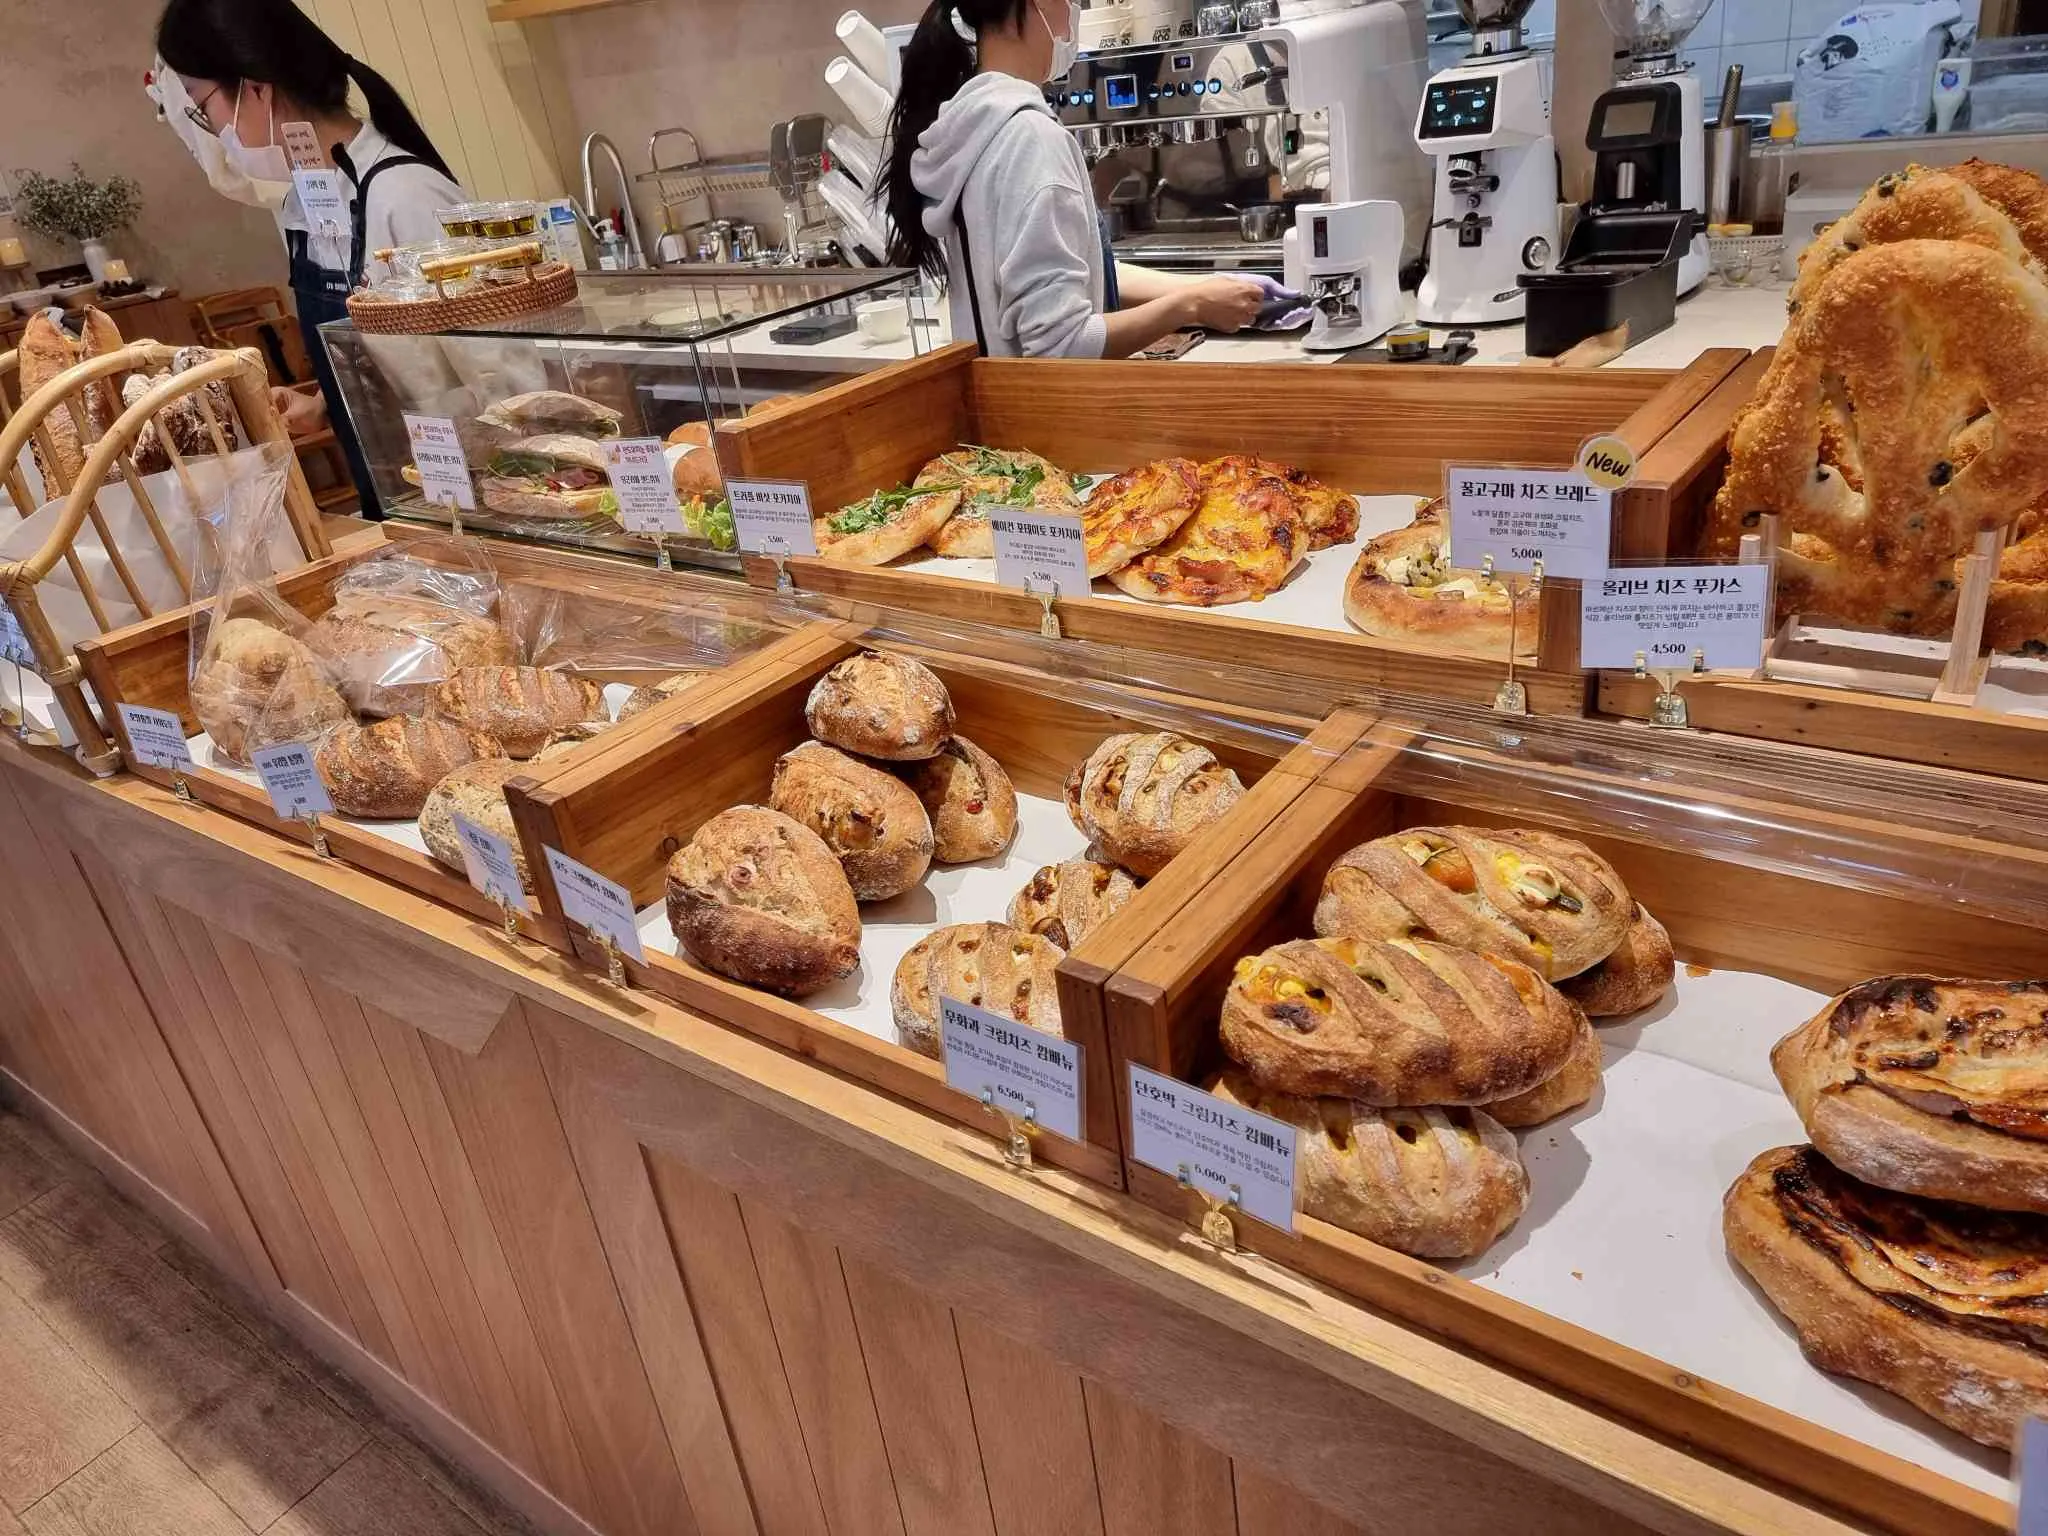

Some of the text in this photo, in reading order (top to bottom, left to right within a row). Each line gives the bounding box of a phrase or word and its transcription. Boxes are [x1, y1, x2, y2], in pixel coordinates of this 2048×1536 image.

[1586, 452, 1630, 477] New
[1460, 481, 1600, 502] 꿀고구마 치즈 브레드
[1017, 522, 1048, 536] 포테이토
[1050, 526, 1080, 541] 포카치아
[1511, 548, 1542, 559] 5,000
[1603, 578, 1742, 596] 올리브 치즈 푸가스
[1651, 644, 1686, 654] 4,500
[945, 1009, 979, 1035] 무화과
[984, 1023, 1033, 1054] 크림치즈
[1037, 1043, 1074, 1072] 깜빠뉴
[997, 1084, 1024, 1102] 6,500
[1135, 1079, 1290, 1157] 단호박 크림치즈 깜빠뉴
[1194, 1163, 1226, 1185] 6,000
